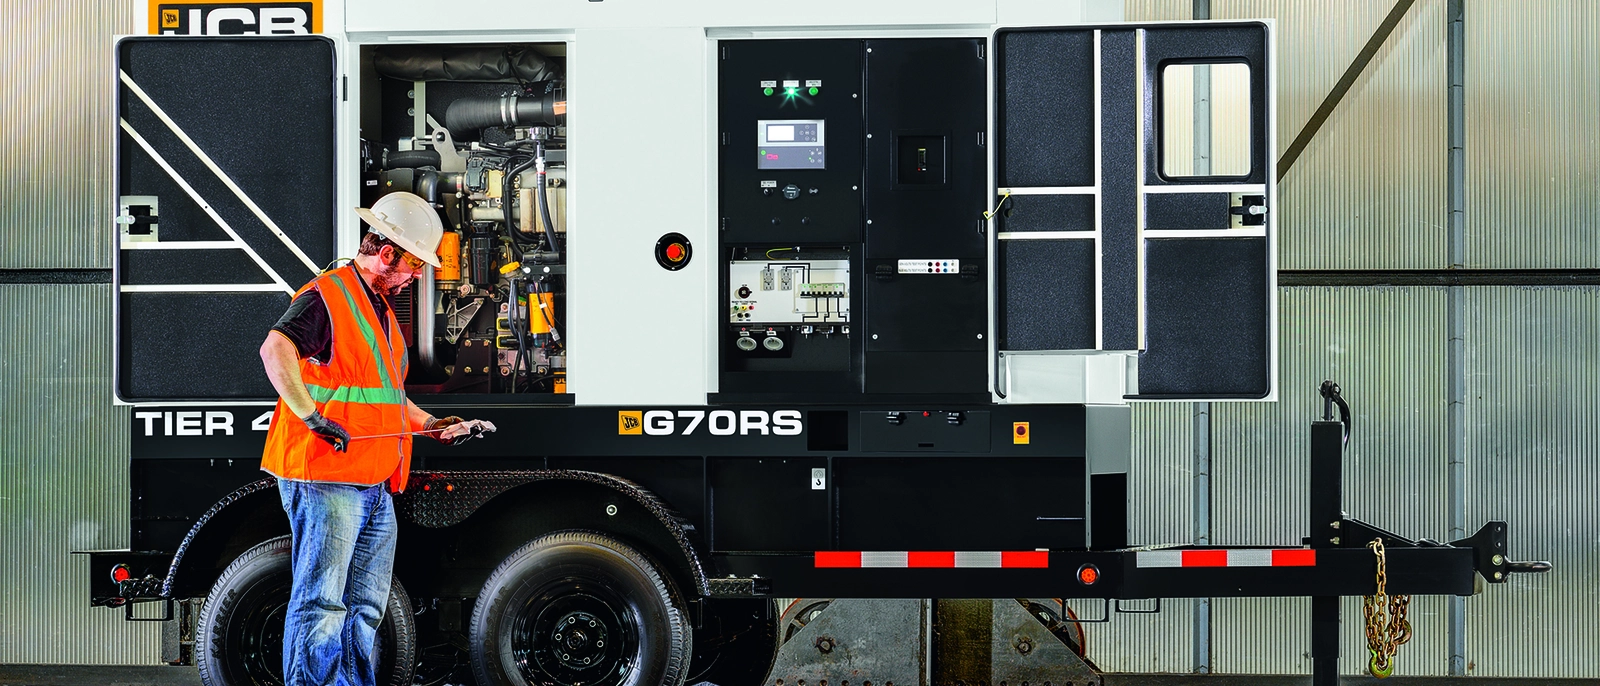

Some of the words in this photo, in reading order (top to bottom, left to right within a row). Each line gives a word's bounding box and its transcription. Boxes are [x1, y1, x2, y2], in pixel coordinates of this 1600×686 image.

[135, 411, 234, 436] TIER
[624, 416, 640, 429] JCB
[643, 409, 803, 436] G70RS
[210, 588, 238, 660] KARRIER
